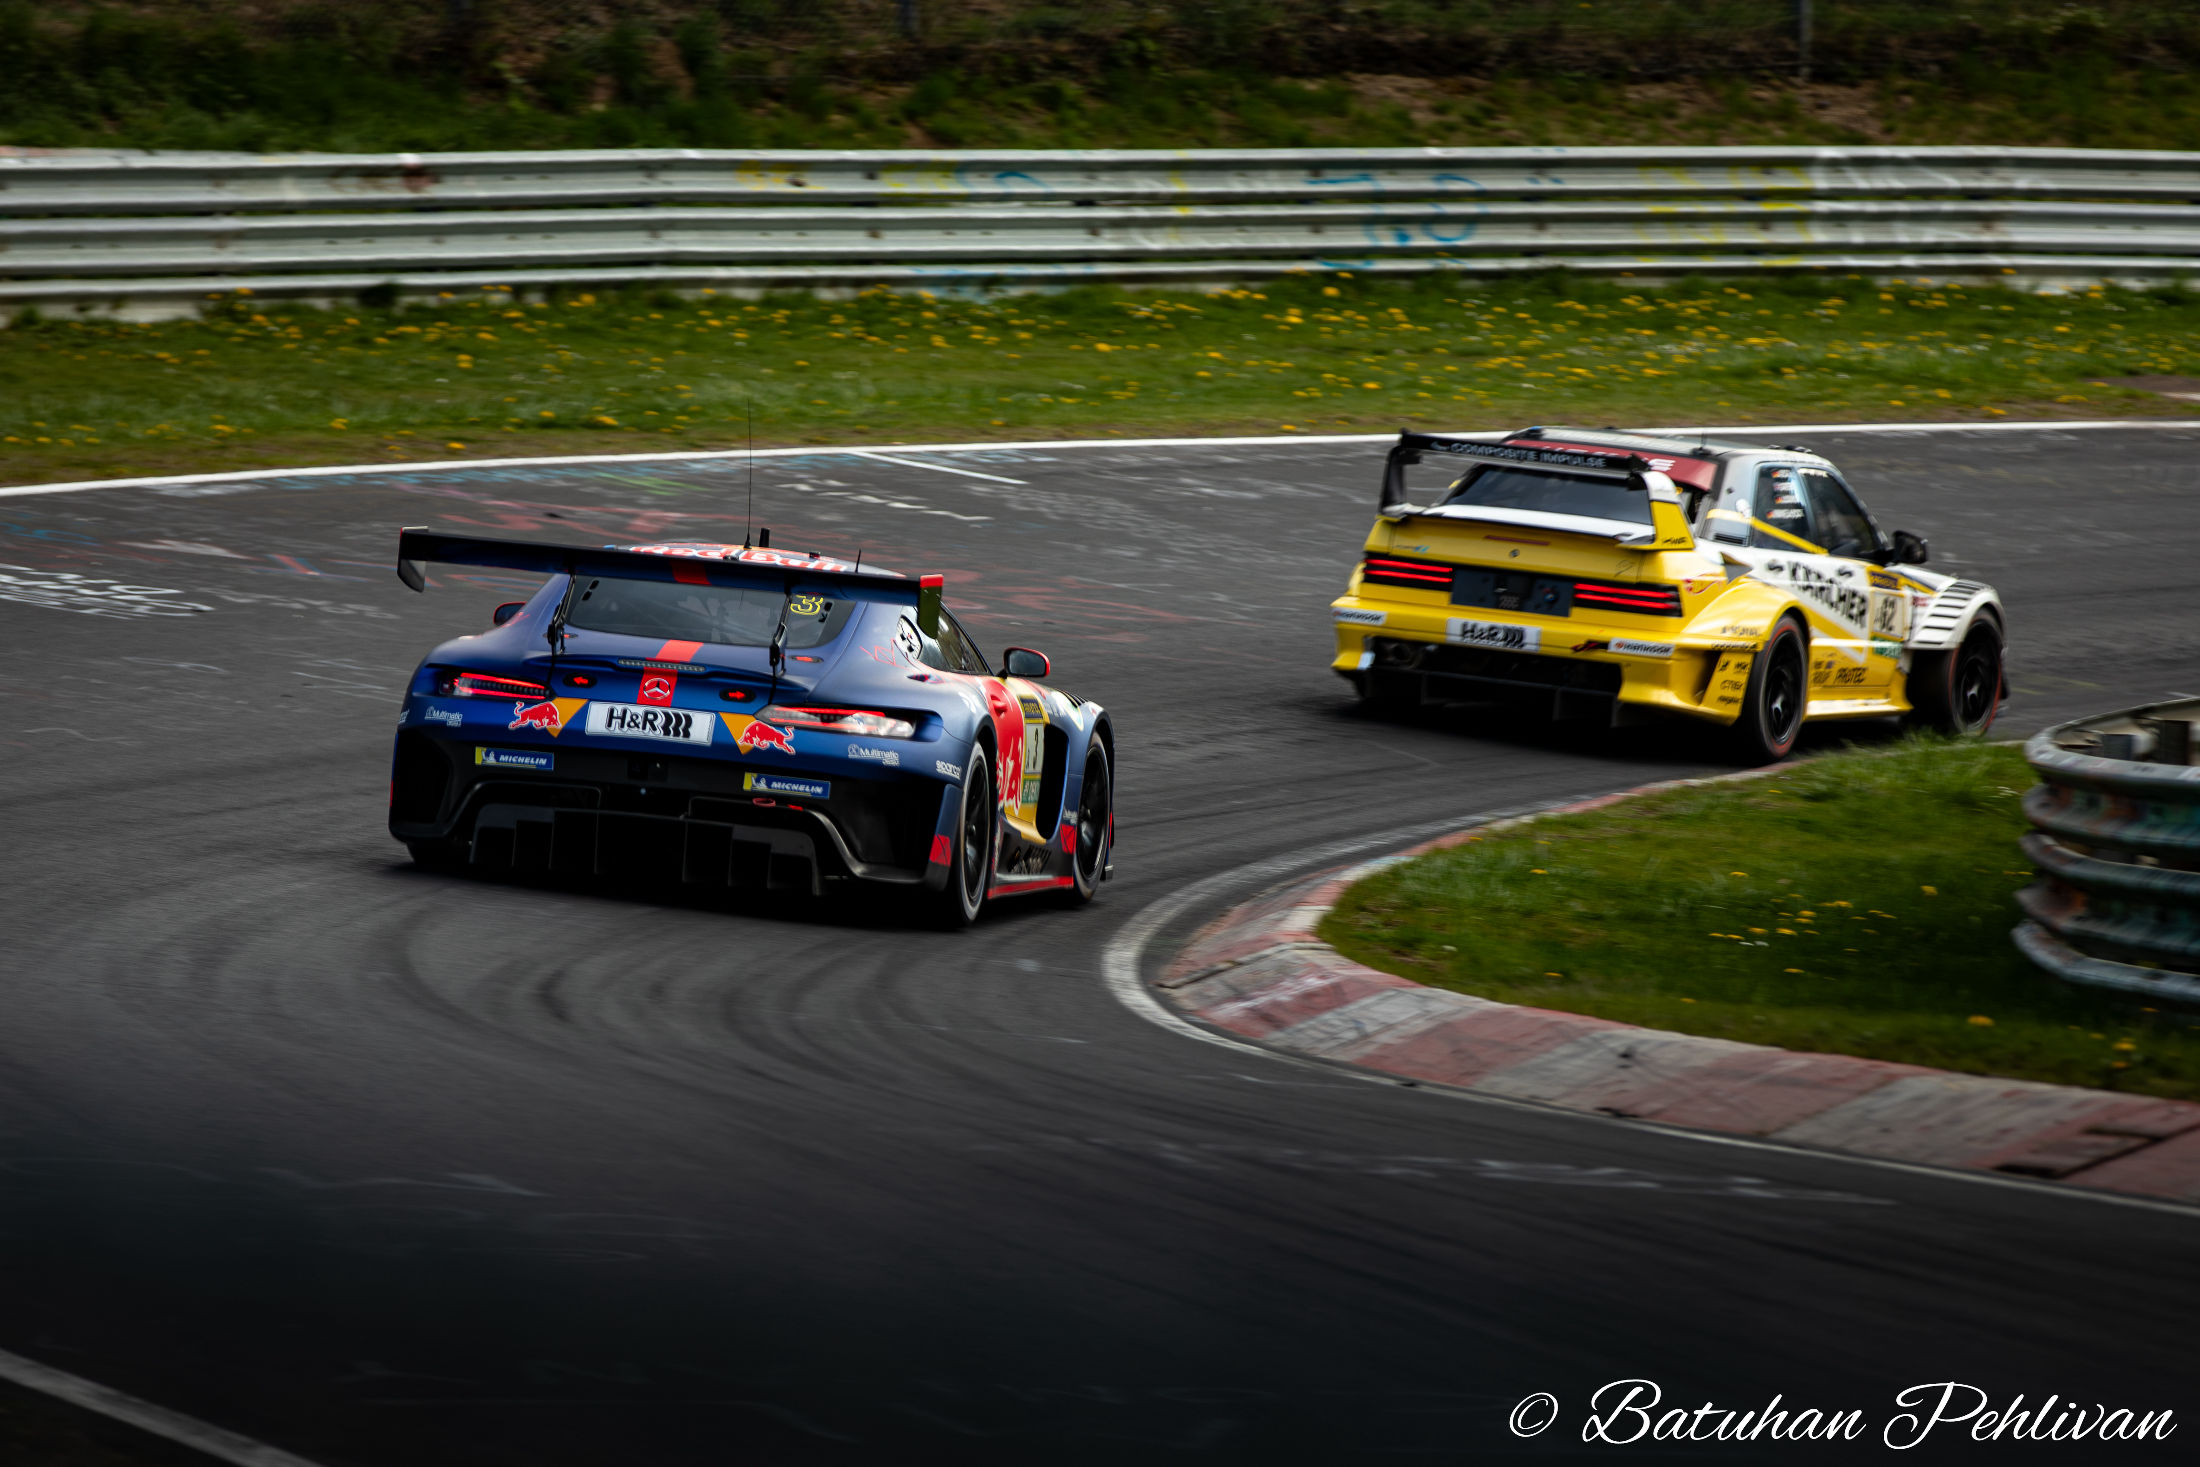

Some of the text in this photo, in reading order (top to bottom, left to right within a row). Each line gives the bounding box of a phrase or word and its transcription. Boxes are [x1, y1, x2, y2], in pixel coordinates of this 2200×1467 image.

[1451, 442, 1607, 469] COMPOSITE IMPULSE
[499, 754, 548, 766] MICHELIN
[770, 780, 824, 795] MICHELIN
